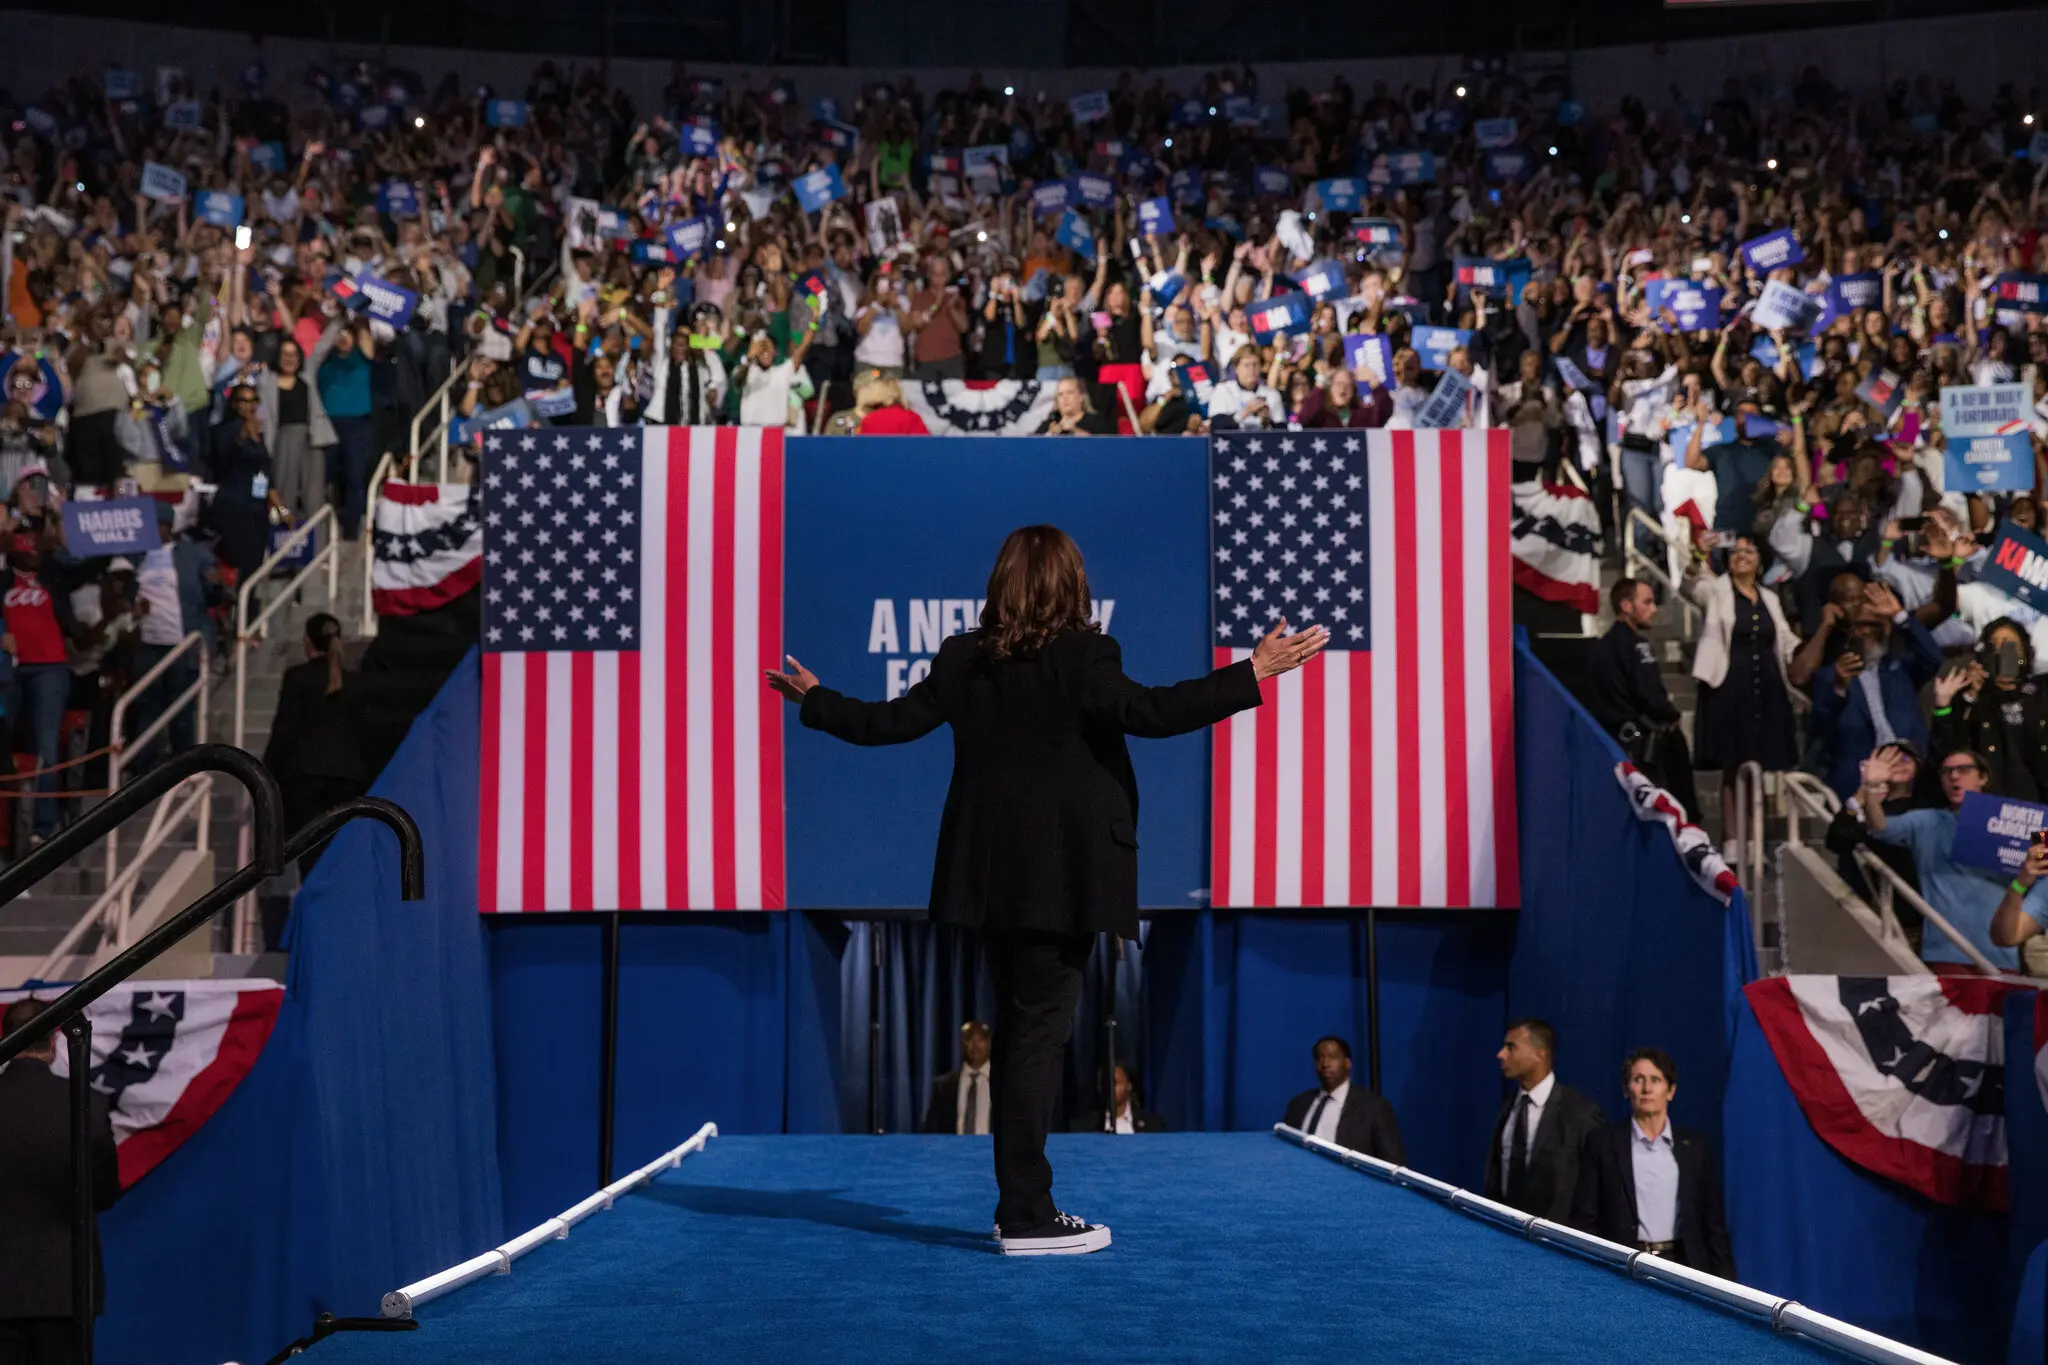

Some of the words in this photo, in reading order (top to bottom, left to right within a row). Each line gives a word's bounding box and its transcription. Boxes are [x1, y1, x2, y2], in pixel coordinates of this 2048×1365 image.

[78, 508, 144, 533] HARRIS
[91, 528, 137, 544] WALZ
[1994, 536, 2048, 591] KAMA
[868, 598, 900, 653] A
